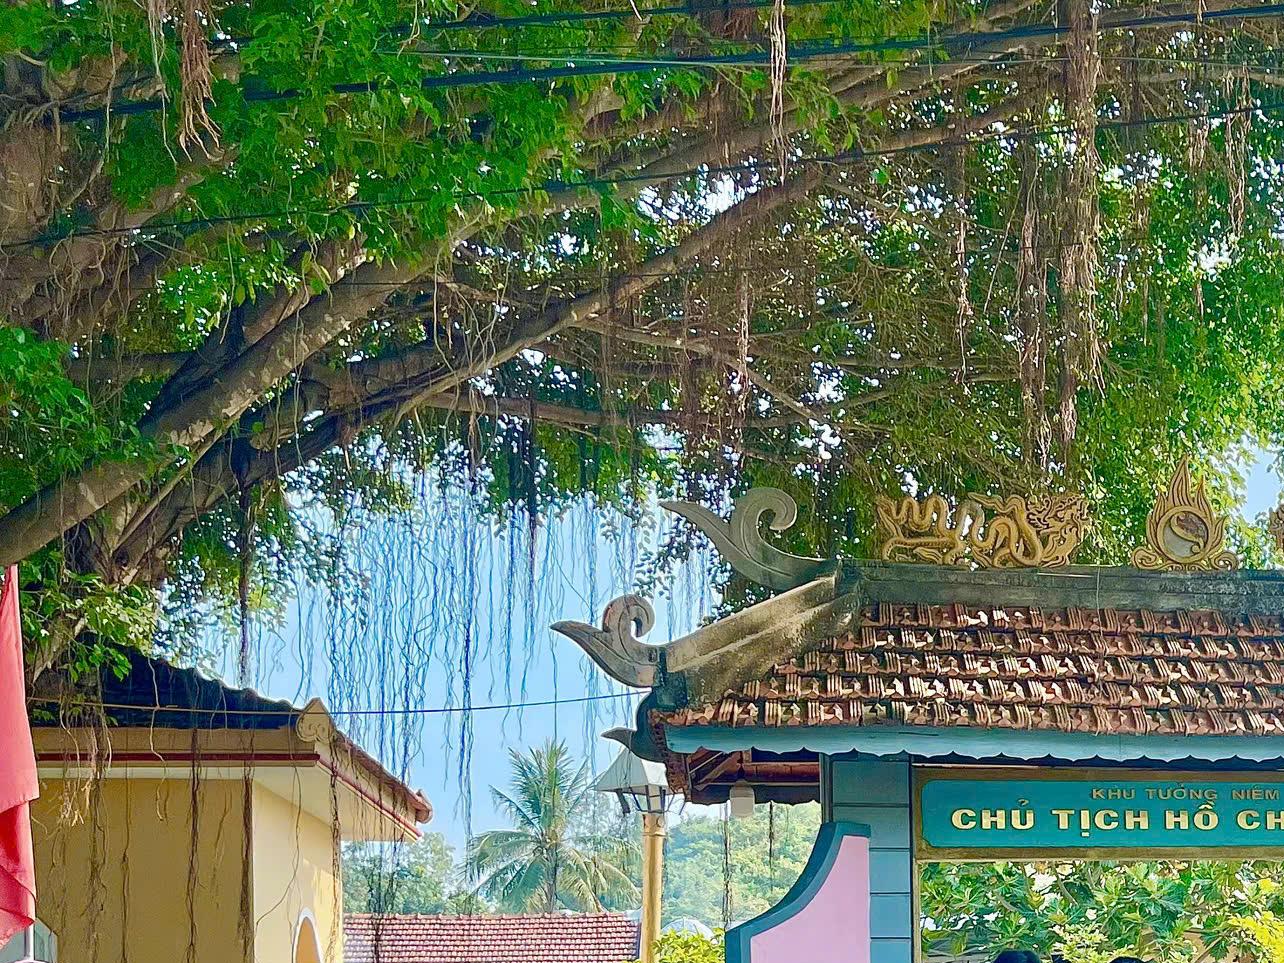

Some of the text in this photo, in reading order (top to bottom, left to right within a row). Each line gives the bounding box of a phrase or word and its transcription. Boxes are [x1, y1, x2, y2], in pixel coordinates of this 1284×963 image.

[1091, 787, 1136, 800] KHU
[950, 798, 1035, 830] CHỦ
[1051, 808, 1149, 837] TỊCH
[1164, 800, 1219, 830] HỒ
